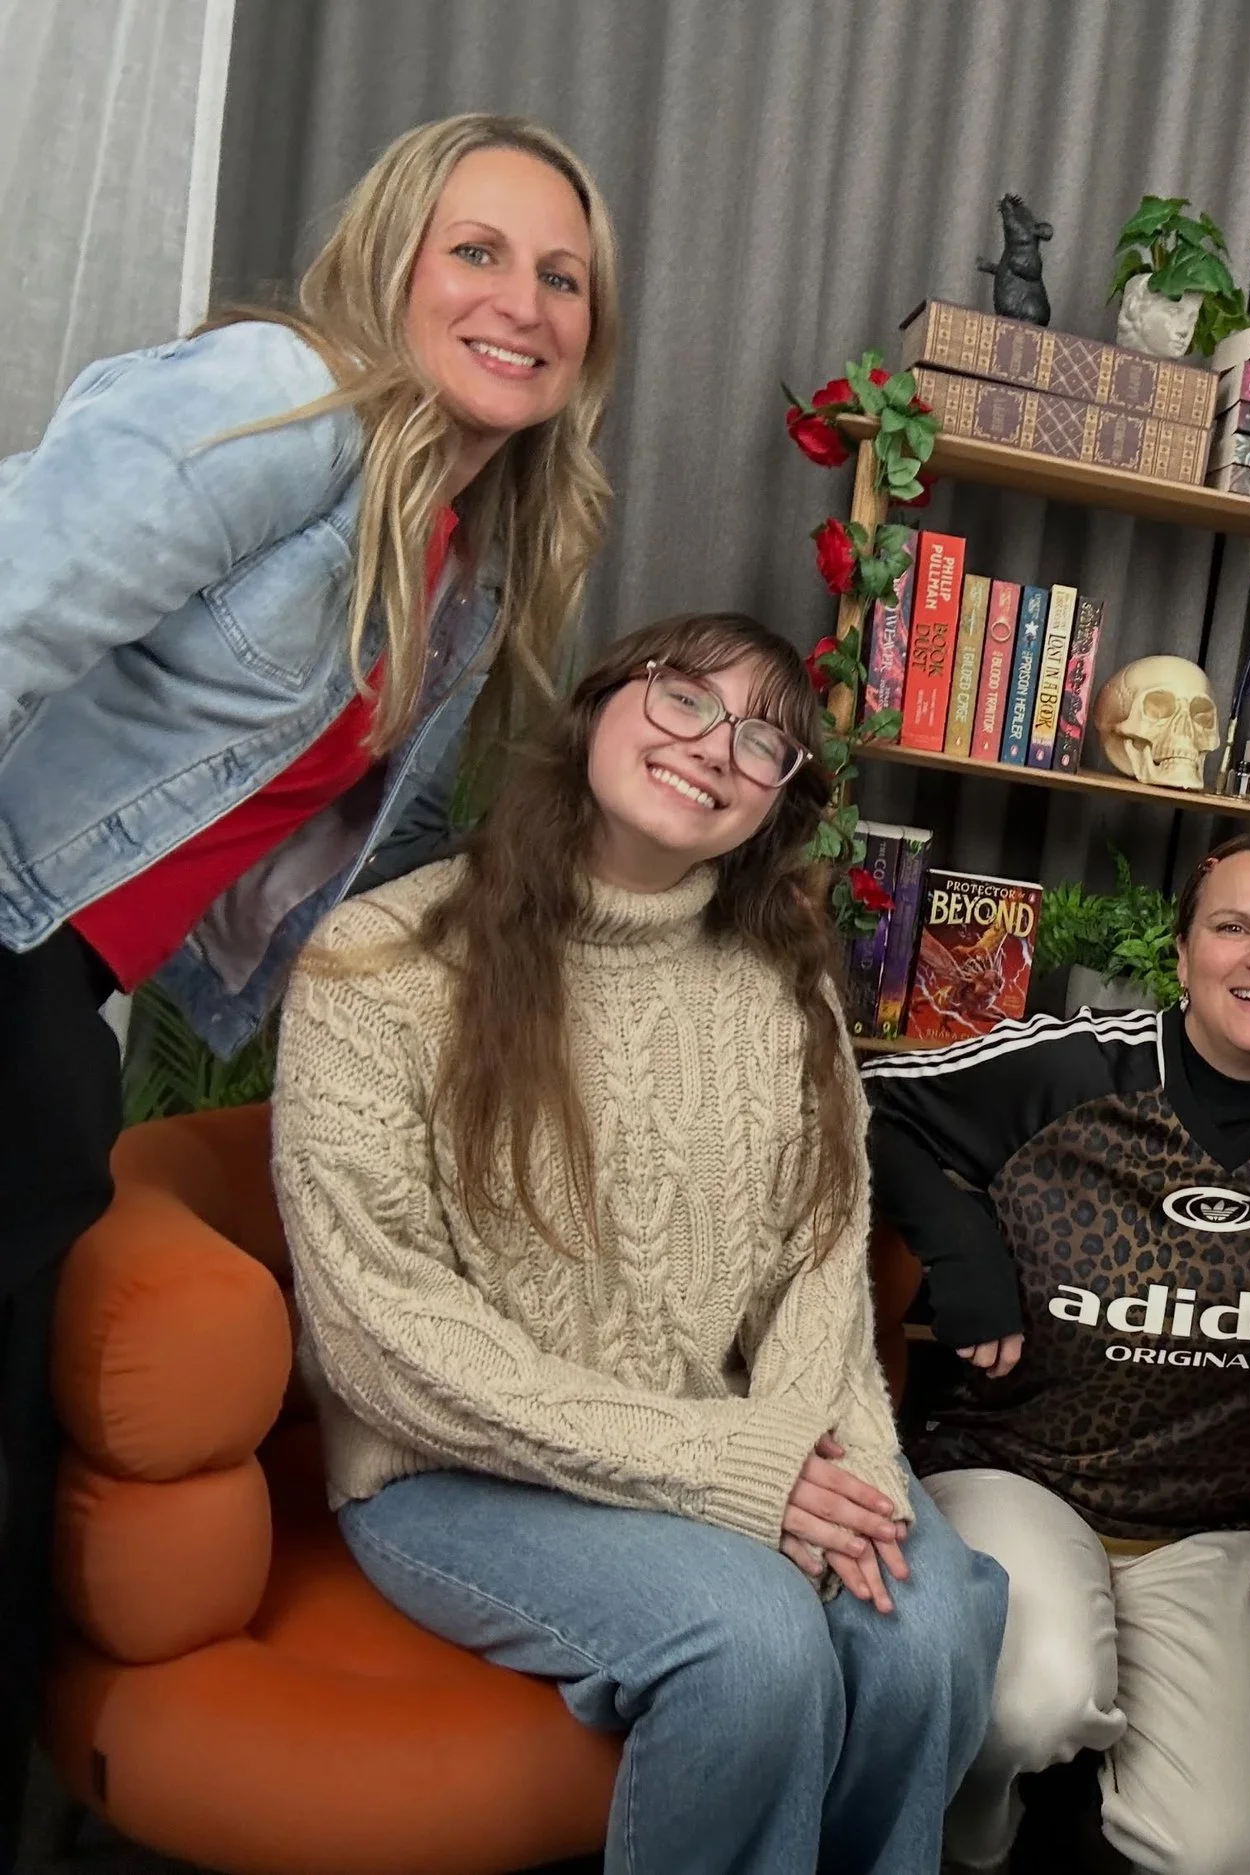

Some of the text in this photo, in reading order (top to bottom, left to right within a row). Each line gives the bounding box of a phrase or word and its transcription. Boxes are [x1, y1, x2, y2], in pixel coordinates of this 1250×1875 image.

[925, 544, 943, 611] PULLMAN
[941, 556, 955, 603] PHILIP
[913, 623, 931, 672] DUST
[928, 622, 949, 677] BOOK
[1046, 633, 1067, 665] LOST
[959, 650, 976, 688] GILDED
[988, 656, 1003, 690] BLOOD
[1018, 656, 1034, 696] PRISON
[1045, 666, 1058, 679] IN
[955, 688, 970, 723] CAGE
[982, 692, 998, 734] TRAITOR
[1009, 698, 1027, 740] HEALER
[1035, 692, 1055, 729] BOOK
[946, 880, 1016, 900] PROTECTOR
[929, 890, 1035, 938] BEYOND
